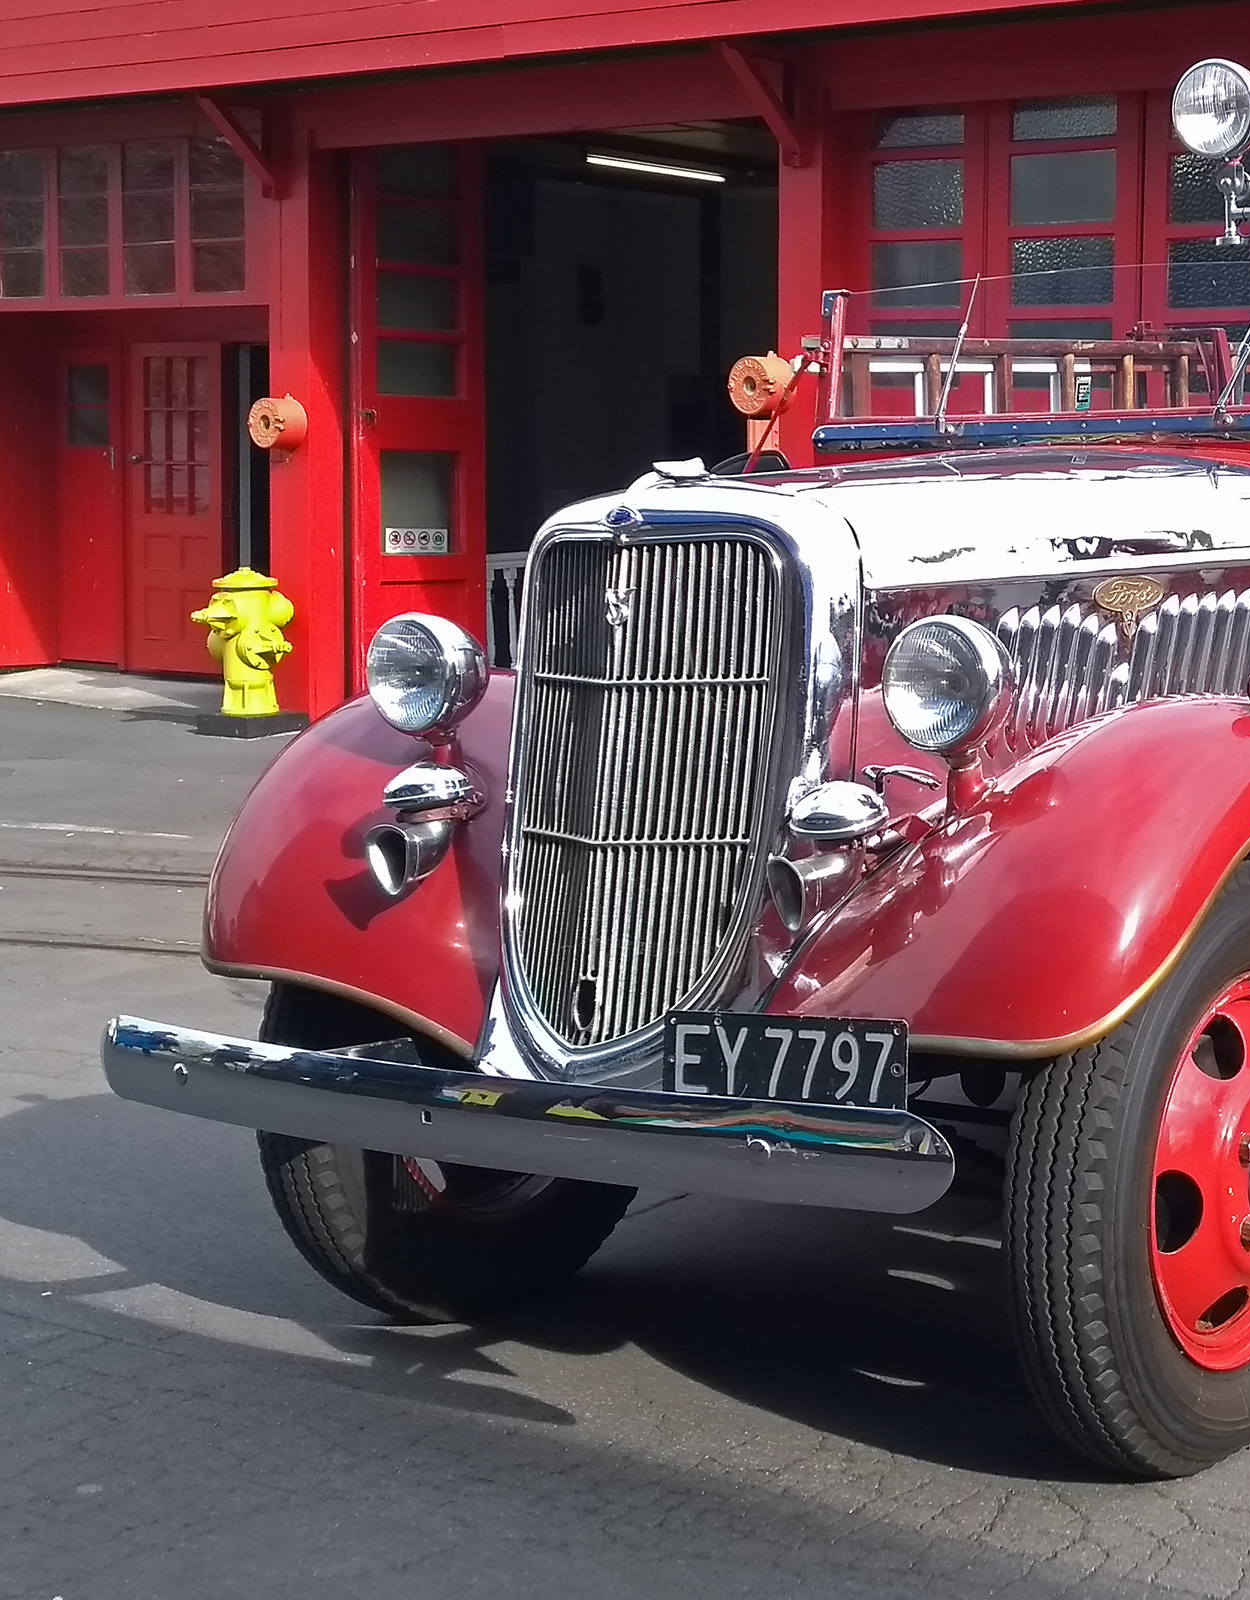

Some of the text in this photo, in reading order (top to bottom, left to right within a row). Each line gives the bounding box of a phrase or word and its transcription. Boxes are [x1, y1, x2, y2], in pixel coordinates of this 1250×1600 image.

[1104, 580, 1157, 605] Ford
[676, 1024, 893, 1102] EY 7797
